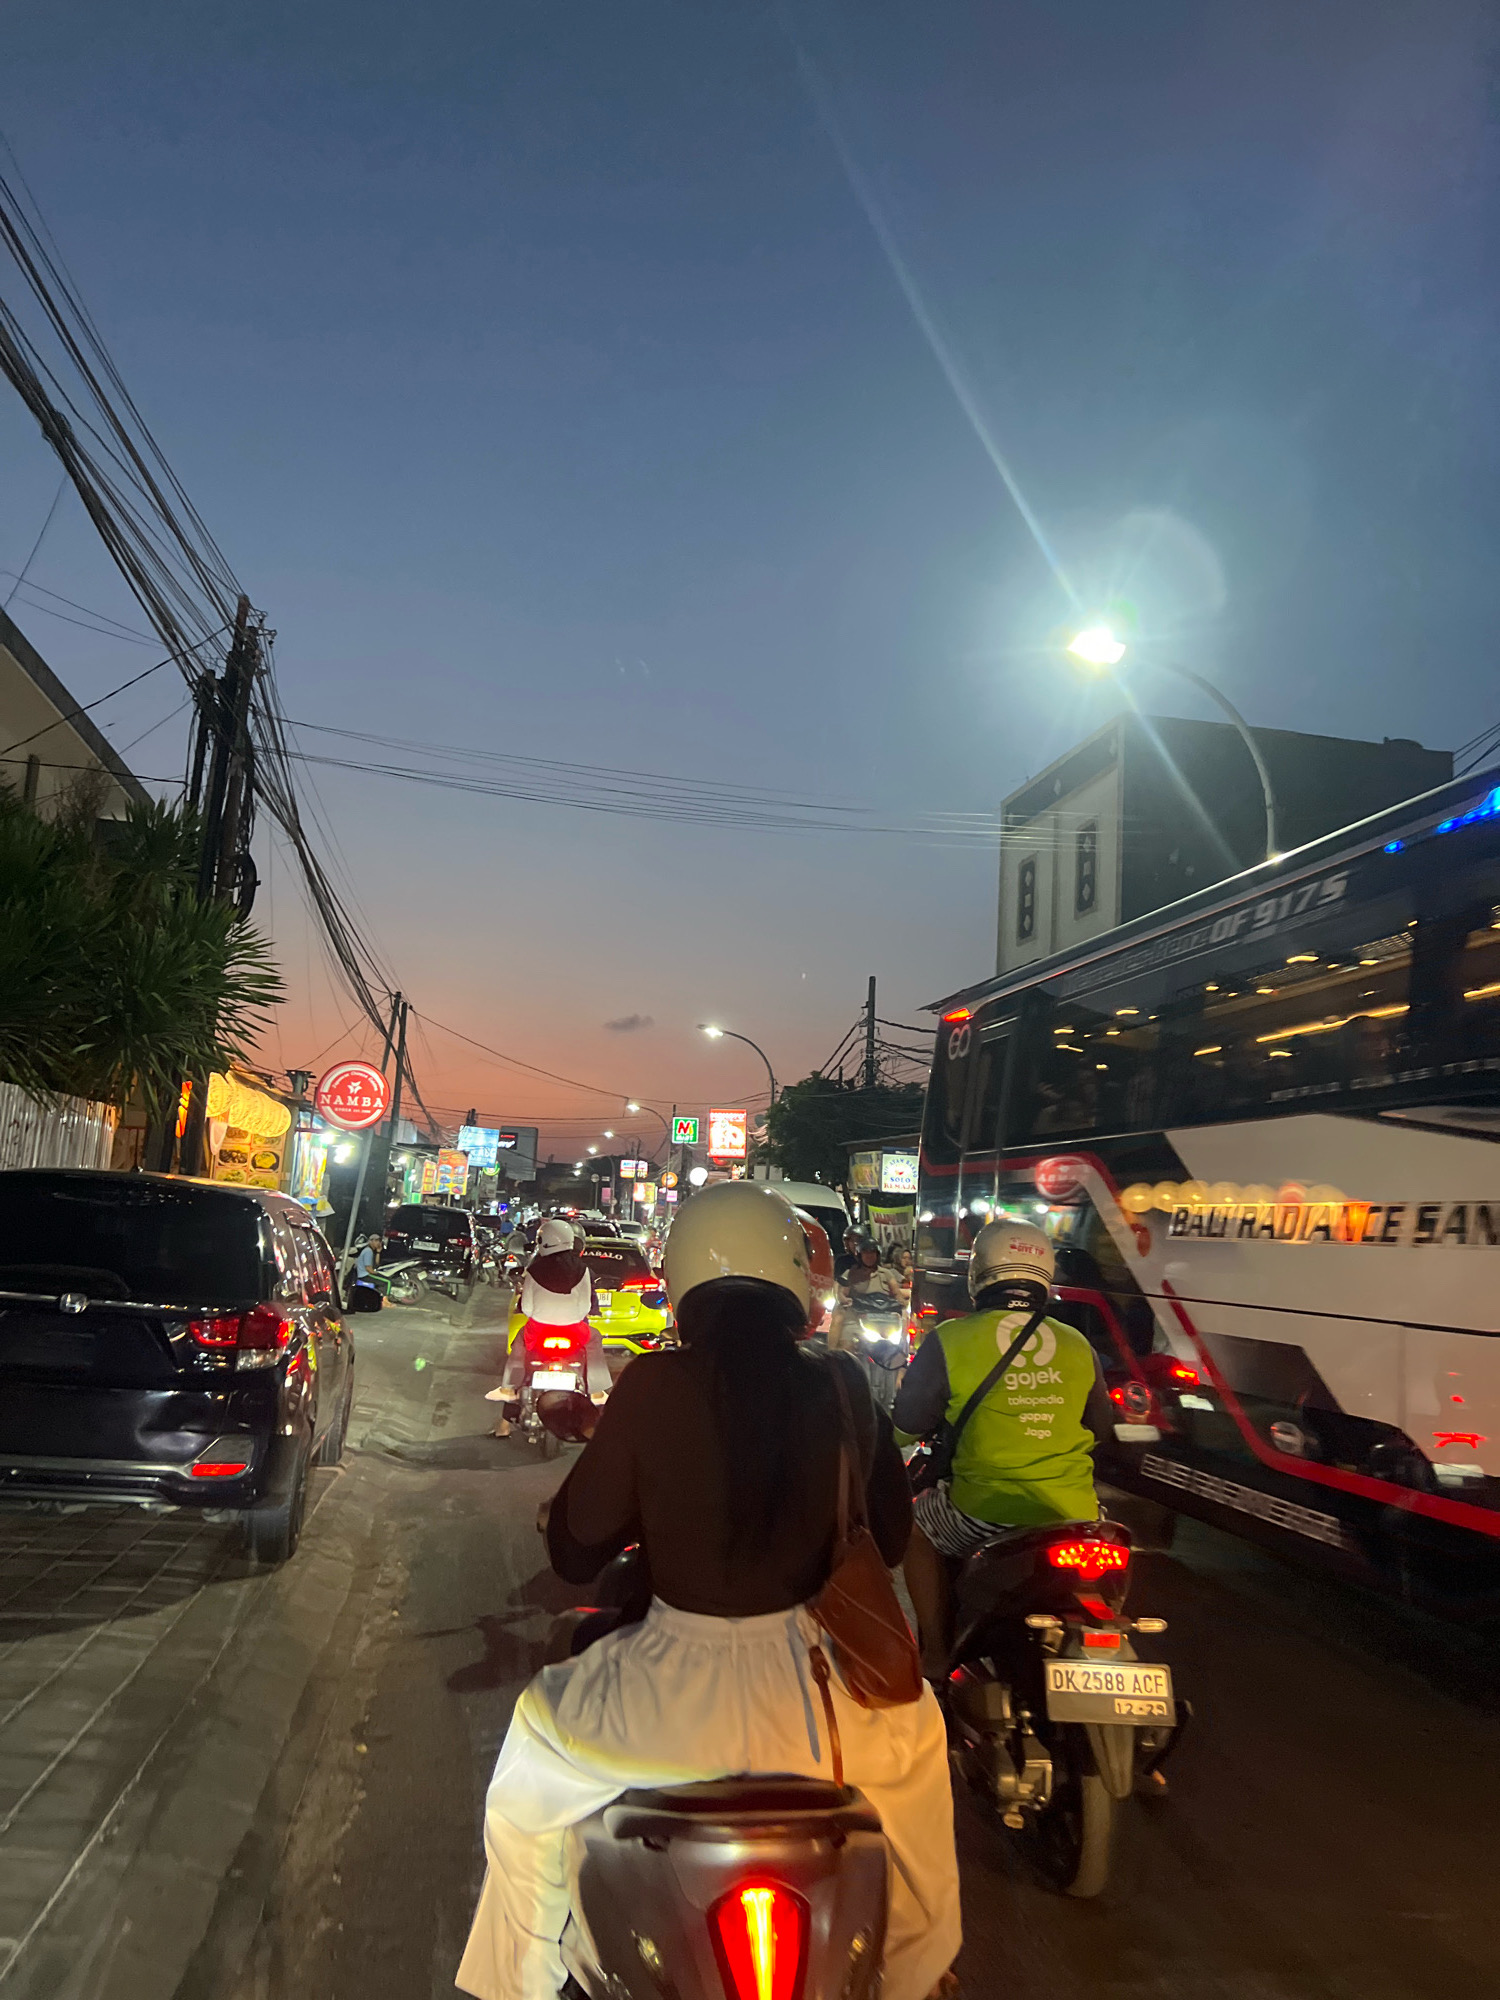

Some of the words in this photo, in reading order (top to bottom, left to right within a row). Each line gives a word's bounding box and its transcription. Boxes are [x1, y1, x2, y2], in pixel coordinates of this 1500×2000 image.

[320, 1094, 384, 1108] NAMBA
[1170, 1204, 1234, 1239] BALI
[1017, 1244, 1033, 1254] GIVE
[1004, 1367, 1063, 1390] gojek
[1008, 1394, 1064, 1407] tokopedia
[1019, 1413, 1055, 1424] gopay
[1024, 1427, 1052, 1439] Jago
[1053, 1669, 1081, 1692] DK
[1081, 1671, 1125, 1692] 2588
[1132, 1673, 1164, 1694] ACF
